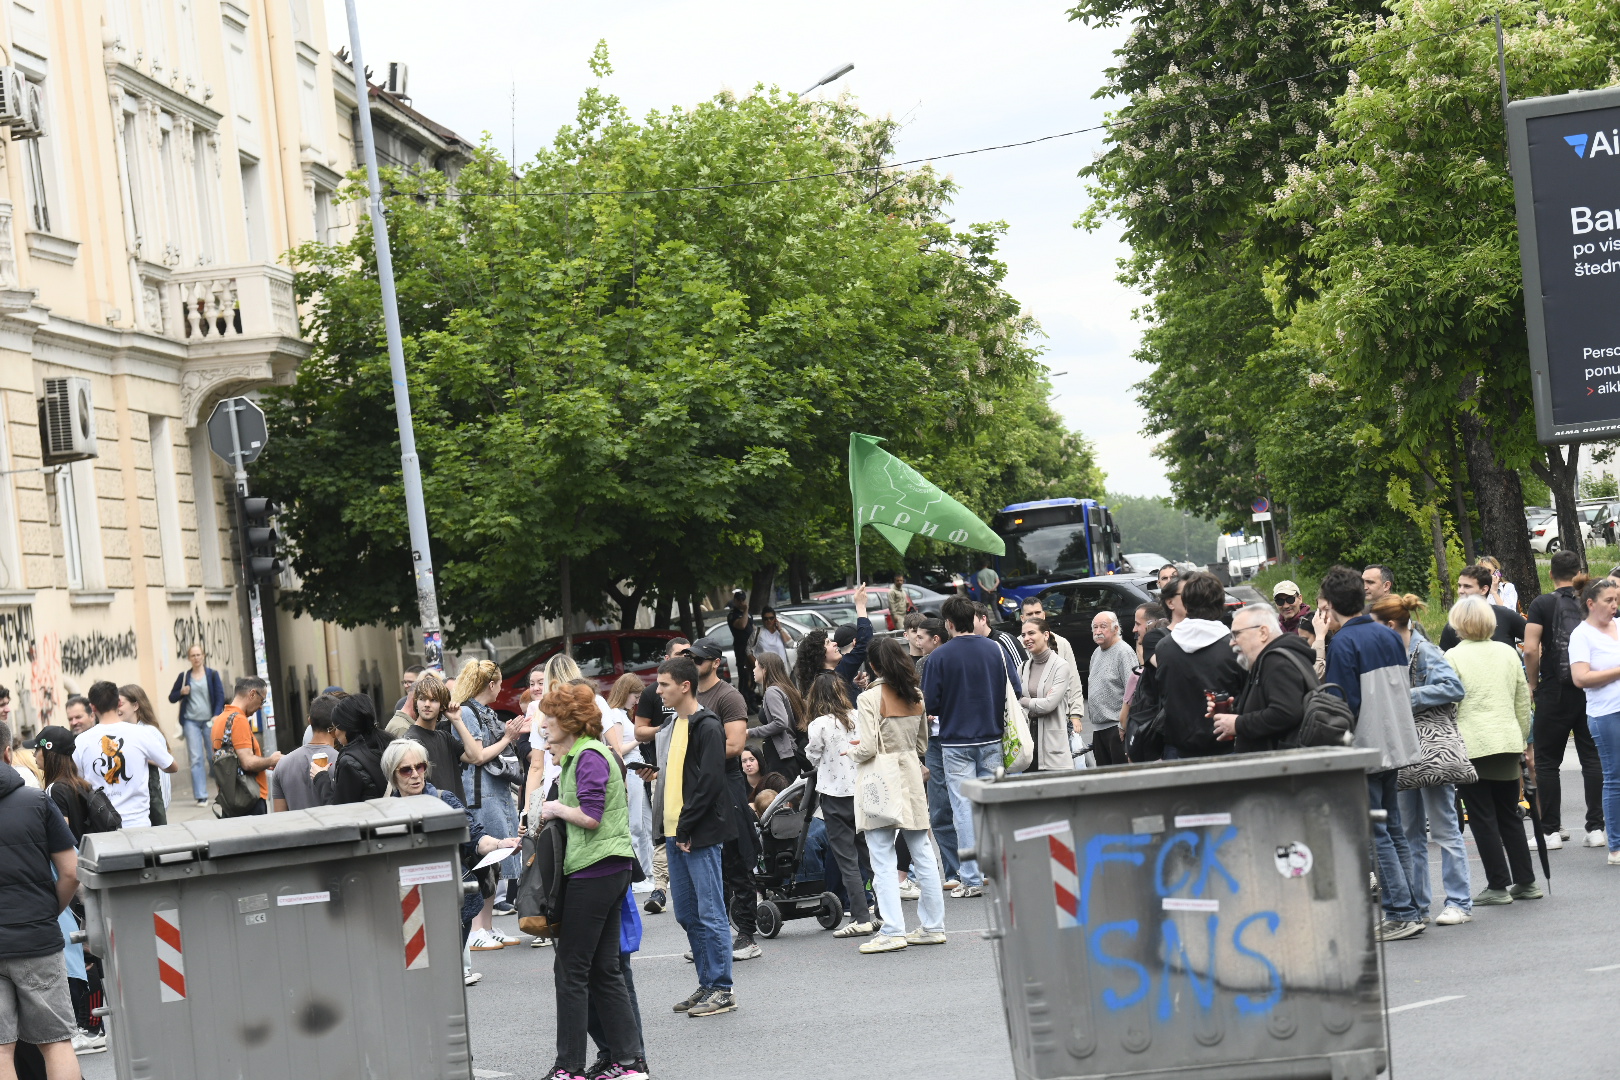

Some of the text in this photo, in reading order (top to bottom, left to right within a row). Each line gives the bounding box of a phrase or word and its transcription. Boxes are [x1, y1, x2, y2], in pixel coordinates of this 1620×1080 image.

[1573, 242, 1595, 260] po
[1078, 826, 1239, 925] FCK
[1090, 910, 1282, 1022] SNS
